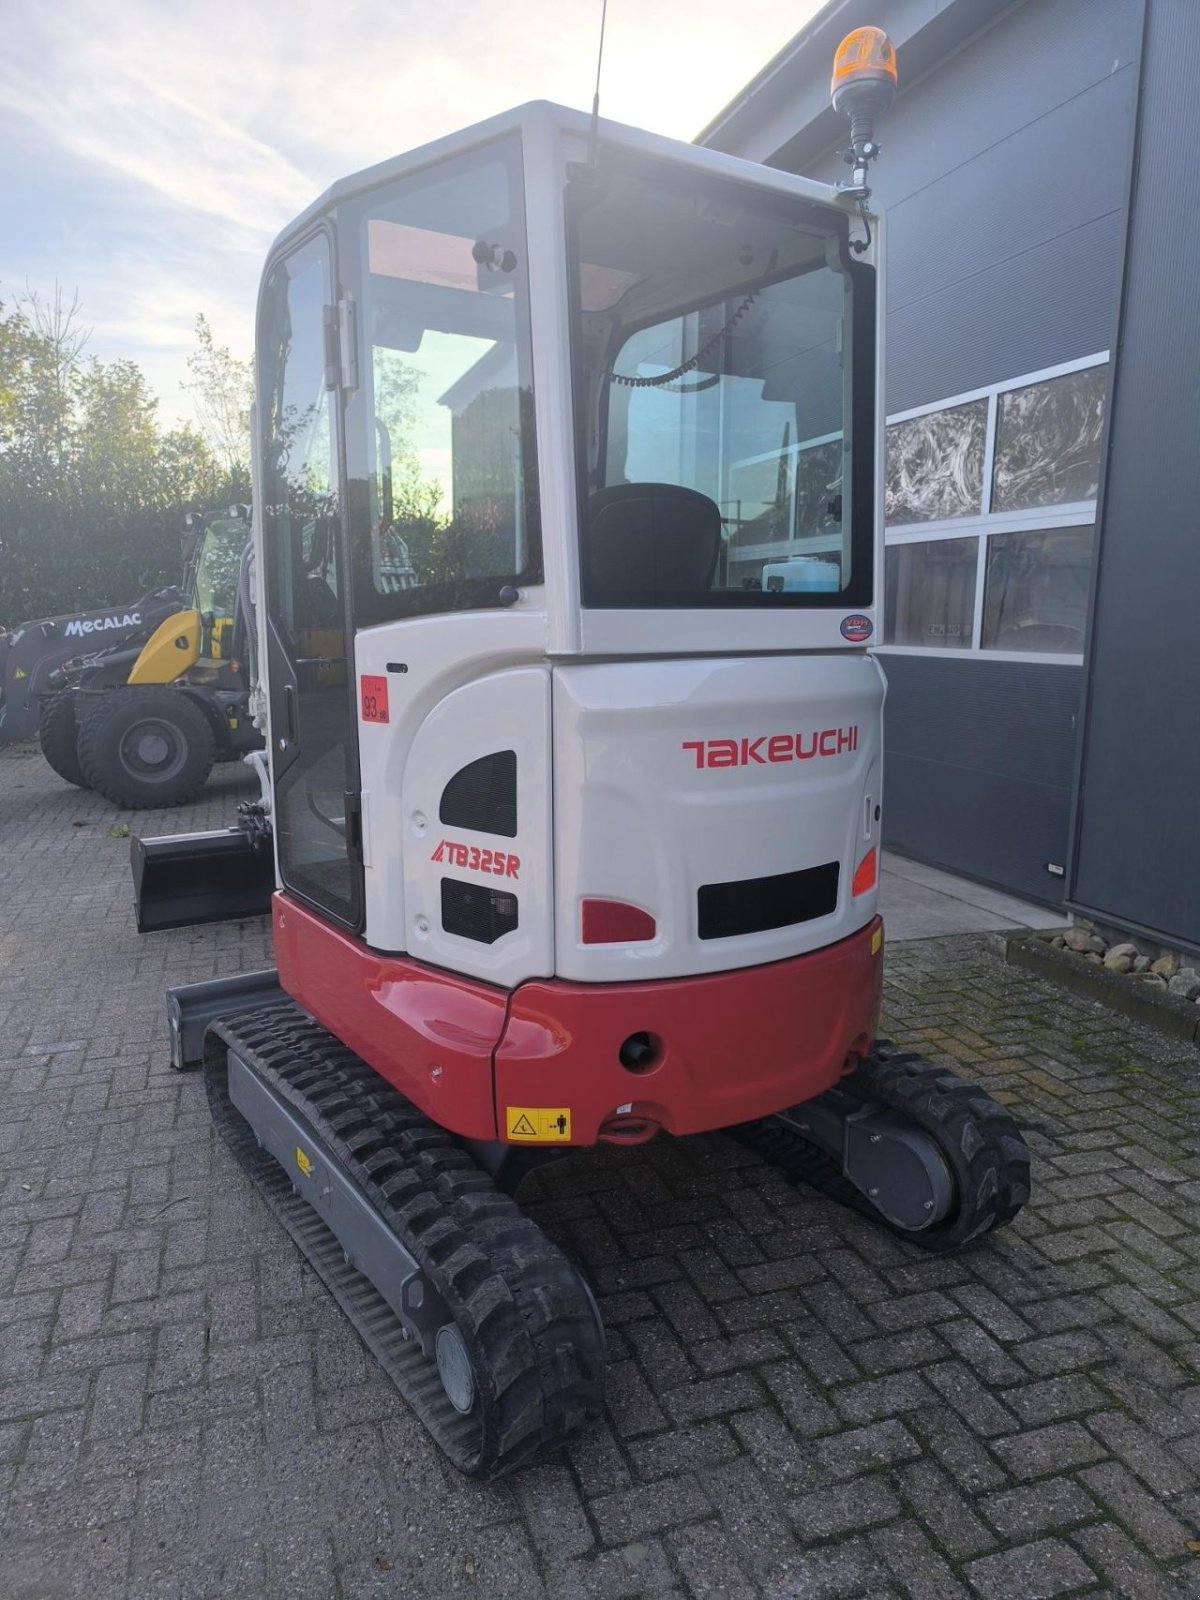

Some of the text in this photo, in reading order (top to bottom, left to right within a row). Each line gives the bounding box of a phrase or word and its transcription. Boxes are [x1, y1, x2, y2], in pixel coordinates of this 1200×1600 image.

[364, 696, 378, 718] 93
[682, 726, 858, 769] TAKEUCHI
[445, 841, 521, 880] TB325R
